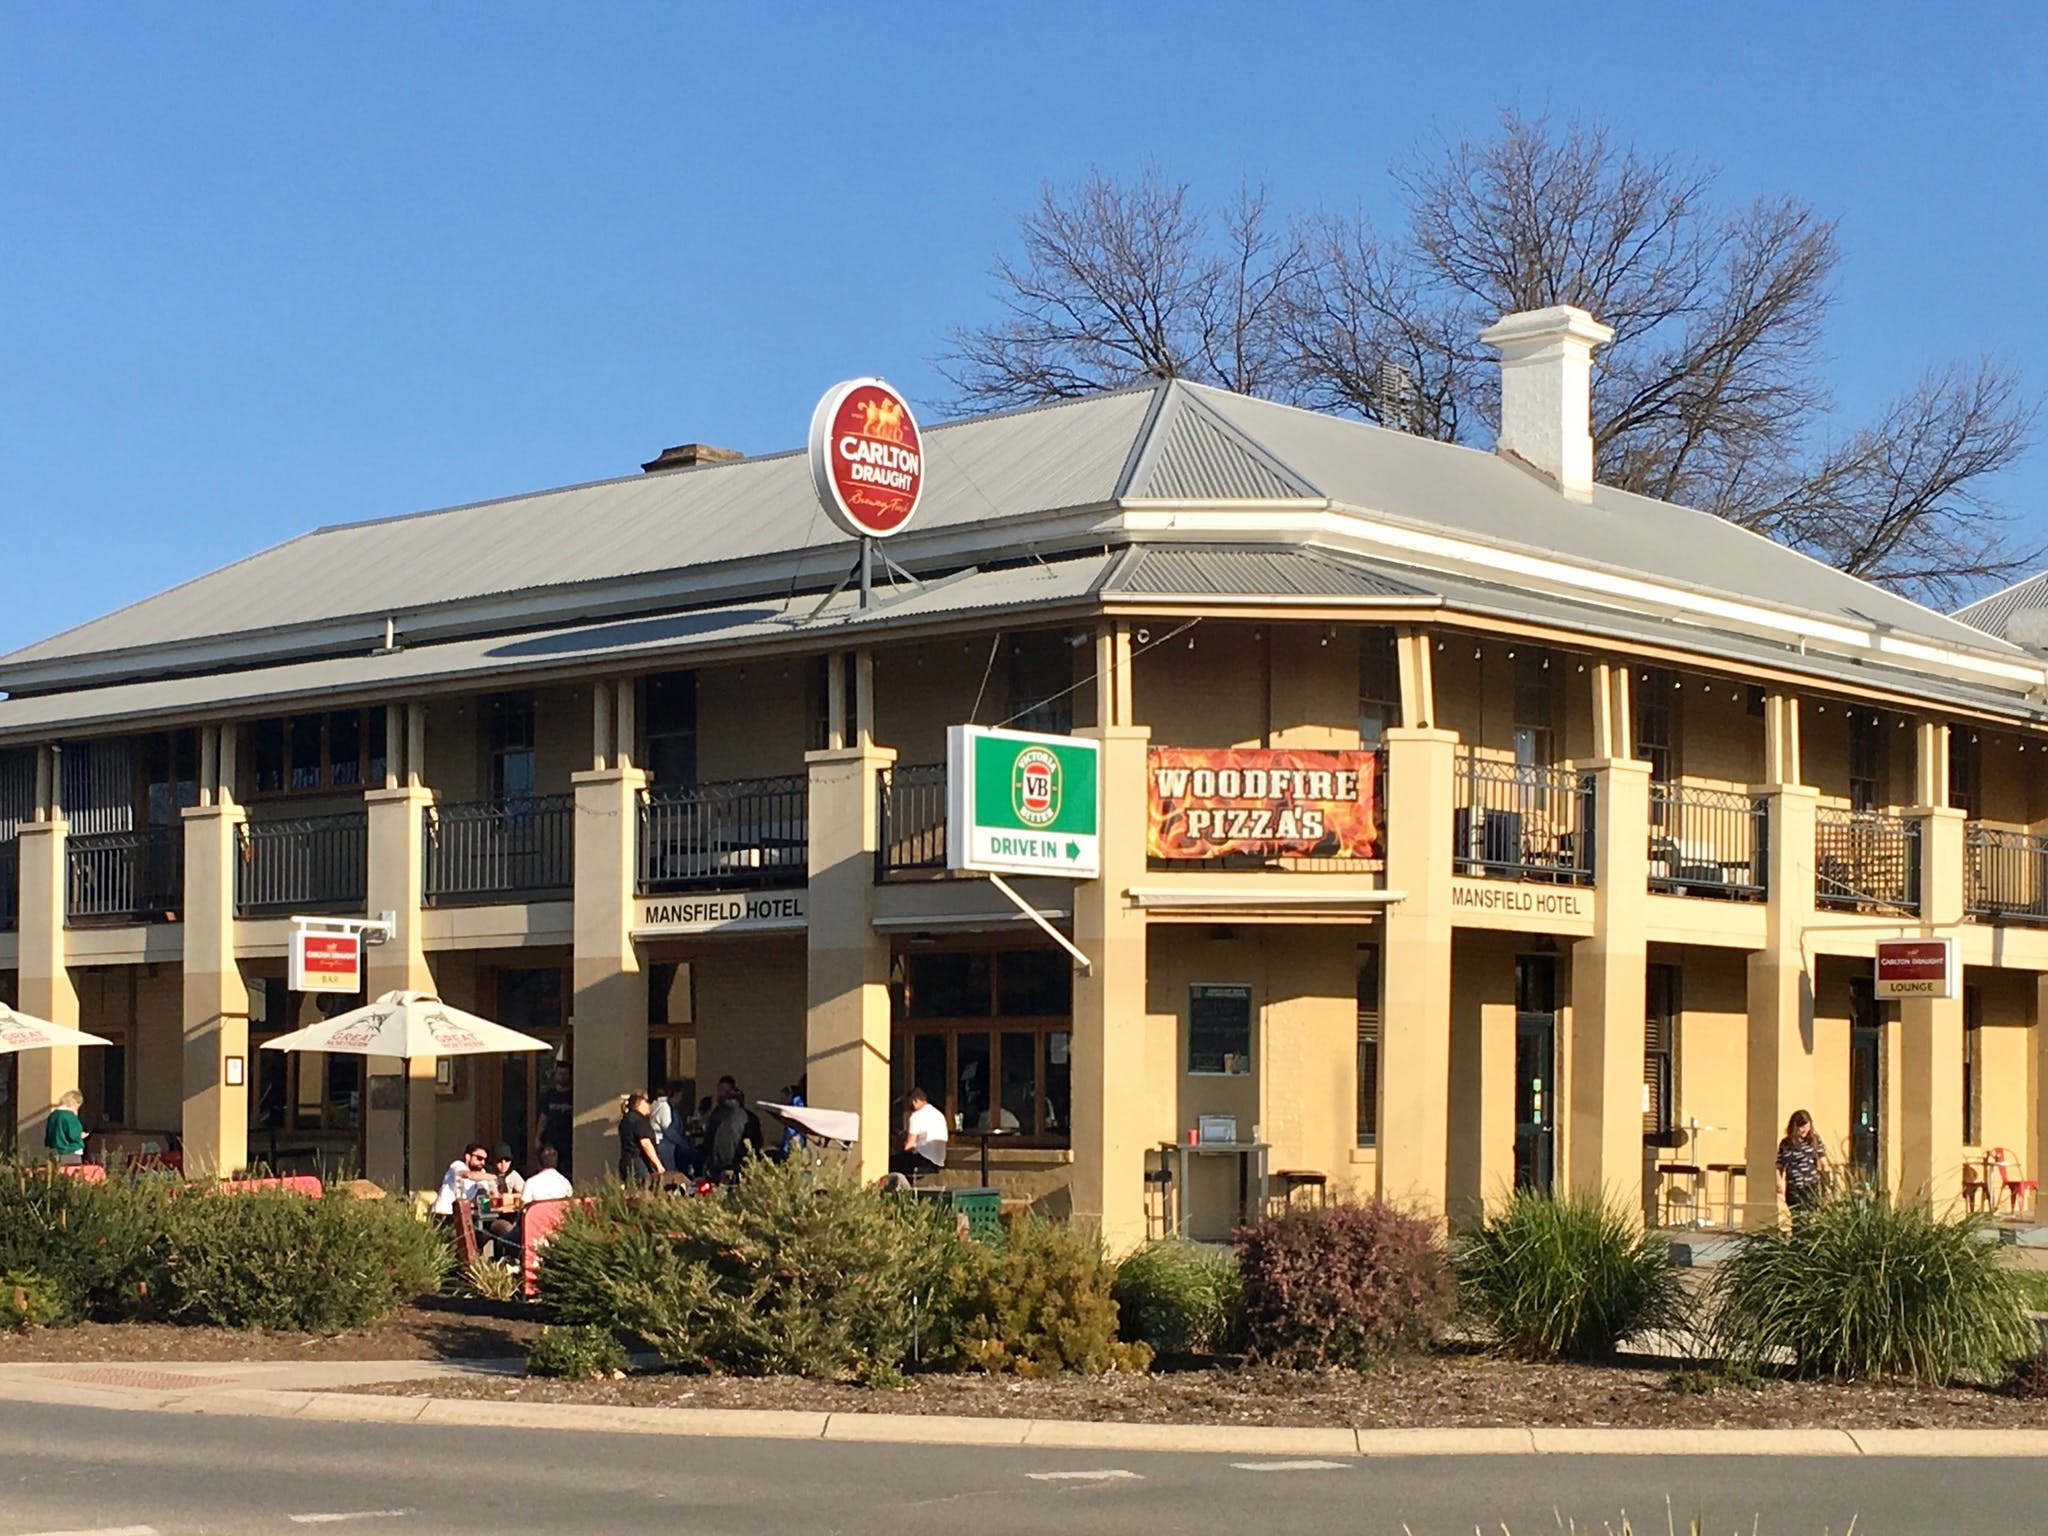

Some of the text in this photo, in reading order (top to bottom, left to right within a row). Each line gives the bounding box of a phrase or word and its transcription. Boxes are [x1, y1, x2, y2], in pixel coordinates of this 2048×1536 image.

[839, 436, 919, 476] CARLTON
[851, 464, 912, 491] DRAUGHT
[1026, 776, 1048, 797] VB
[1154, 768, 1359, 801] WOODFIRE
[1186, 806, 1324, 839] PIZZA'S
[991, 836, 1057, 858] DRIVE IN
[645, 899, 803, 923] MANSFIELD HOTEL
[1452, 887, 1581, 914] MANSFIELD HOTEL
[1890, 982, 1934, 992] LOUNGE
